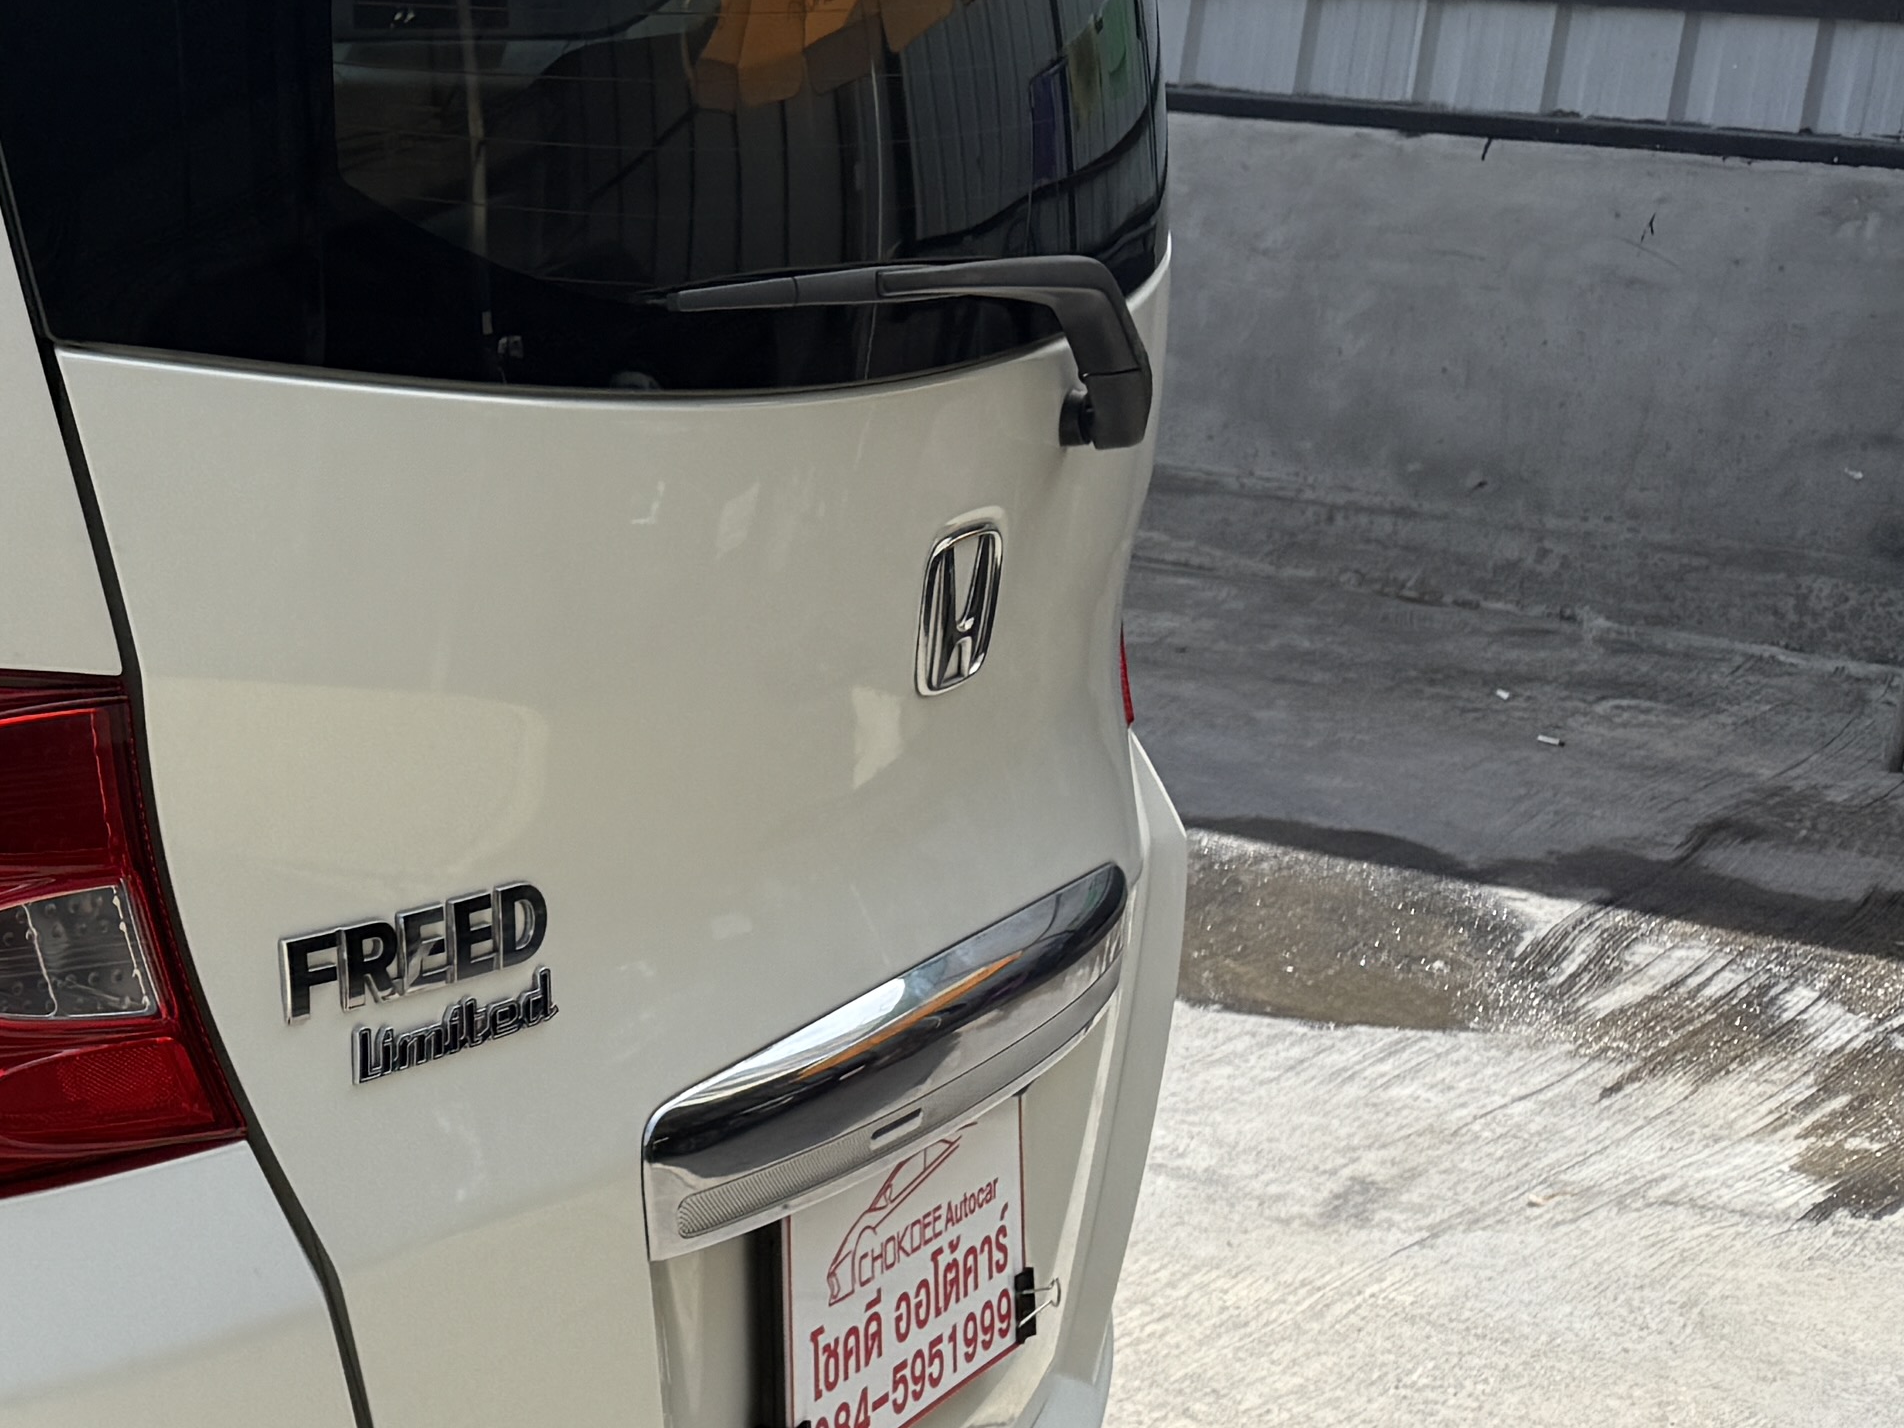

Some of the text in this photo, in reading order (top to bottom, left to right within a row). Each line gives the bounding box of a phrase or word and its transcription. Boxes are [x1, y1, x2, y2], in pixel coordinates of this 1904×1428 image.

[278, 881, 548, 1026] FREED
[810, 1202, 1009, 1402] โชคดี ออโต้คาร์
[858, 1177, 999, 1288] CHOKDEE Autocar
